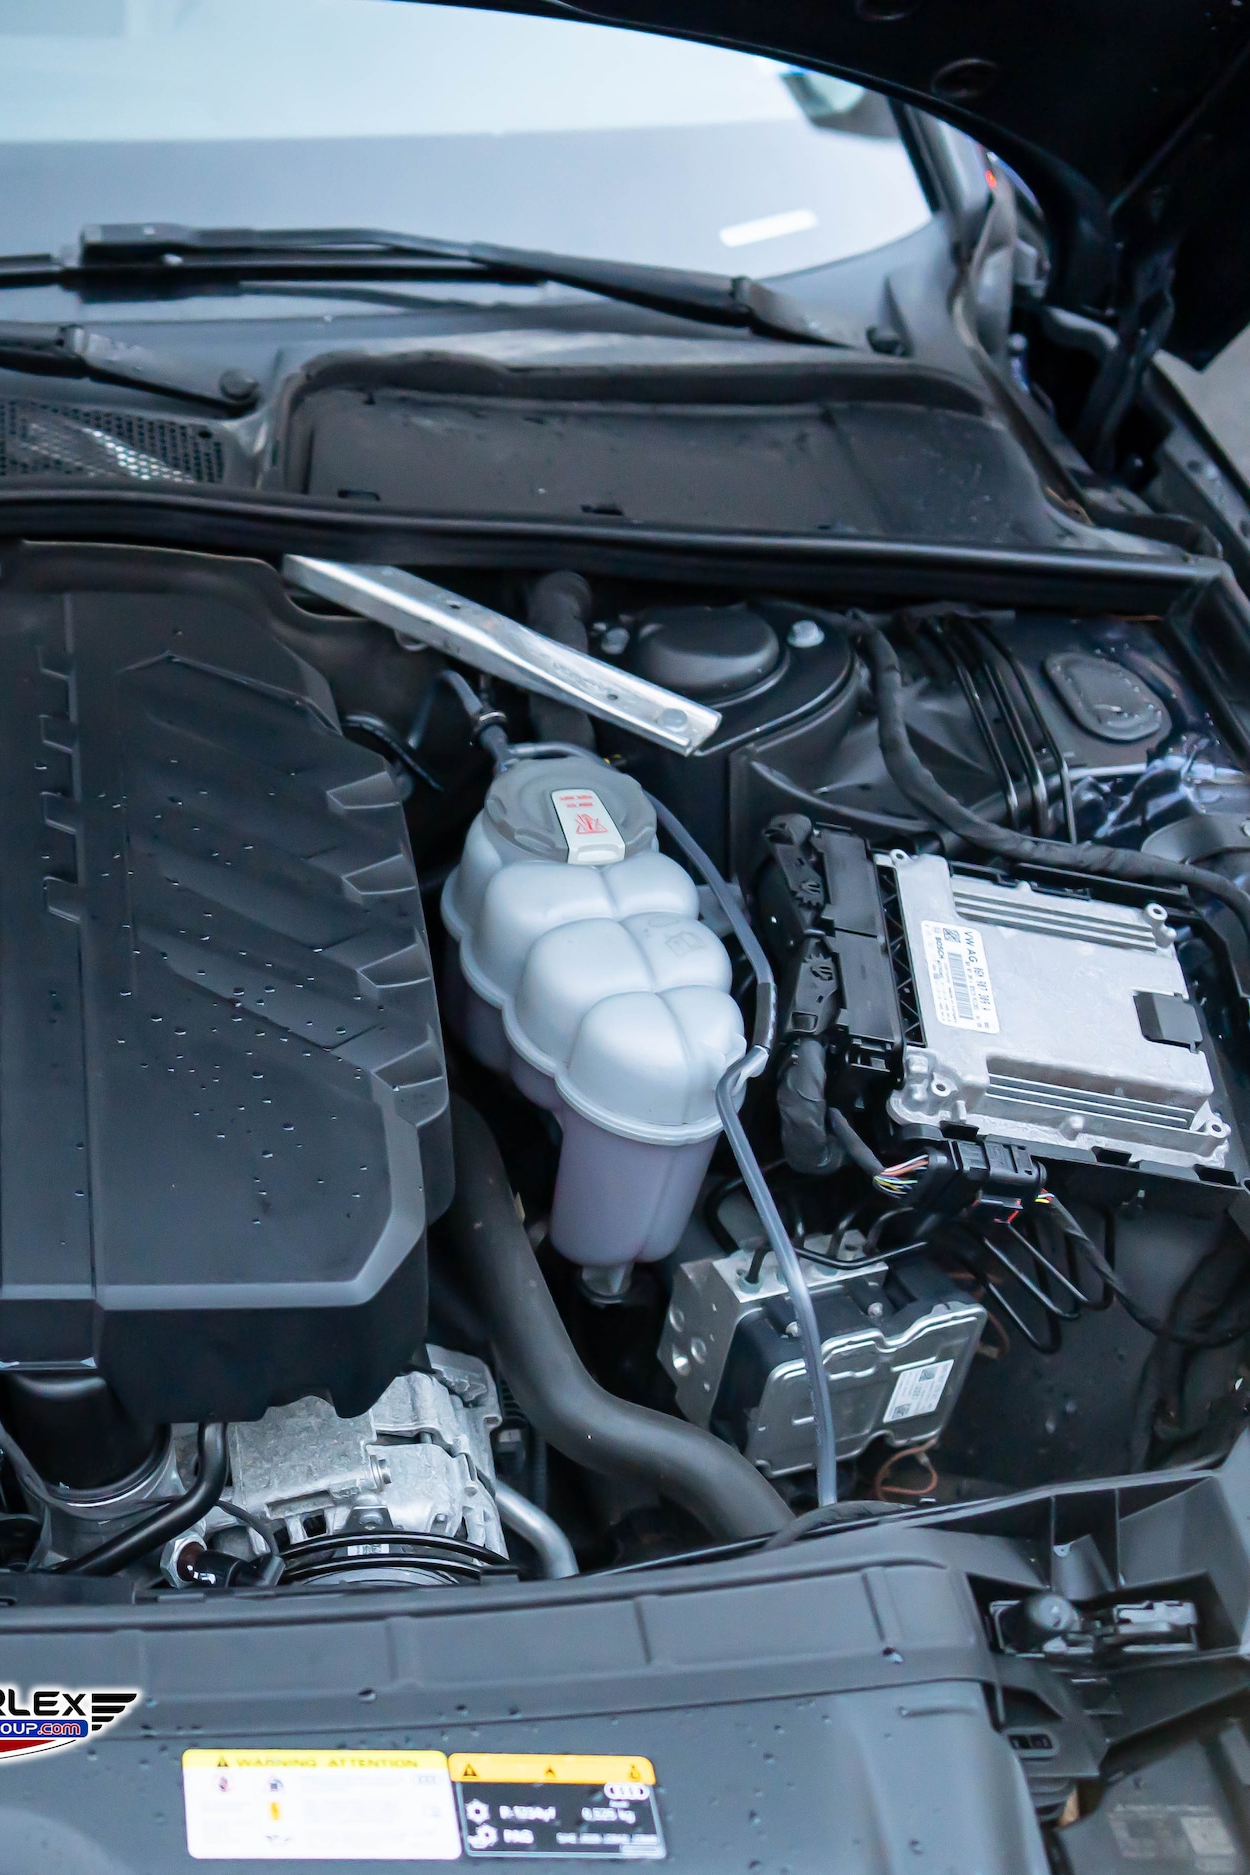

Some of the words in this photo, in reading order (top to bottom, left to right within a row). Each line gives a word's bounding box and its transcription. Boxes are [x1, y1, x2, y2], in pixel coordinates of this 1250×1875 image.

[964, 931, 975, 947] VW
[935, 937, 945, 959] BOSCH
[967, 948, 978, 963] AG
[236, 1758, 318, 1768] WARNING
[327, 1758, 419, 1768] ATTENTION
